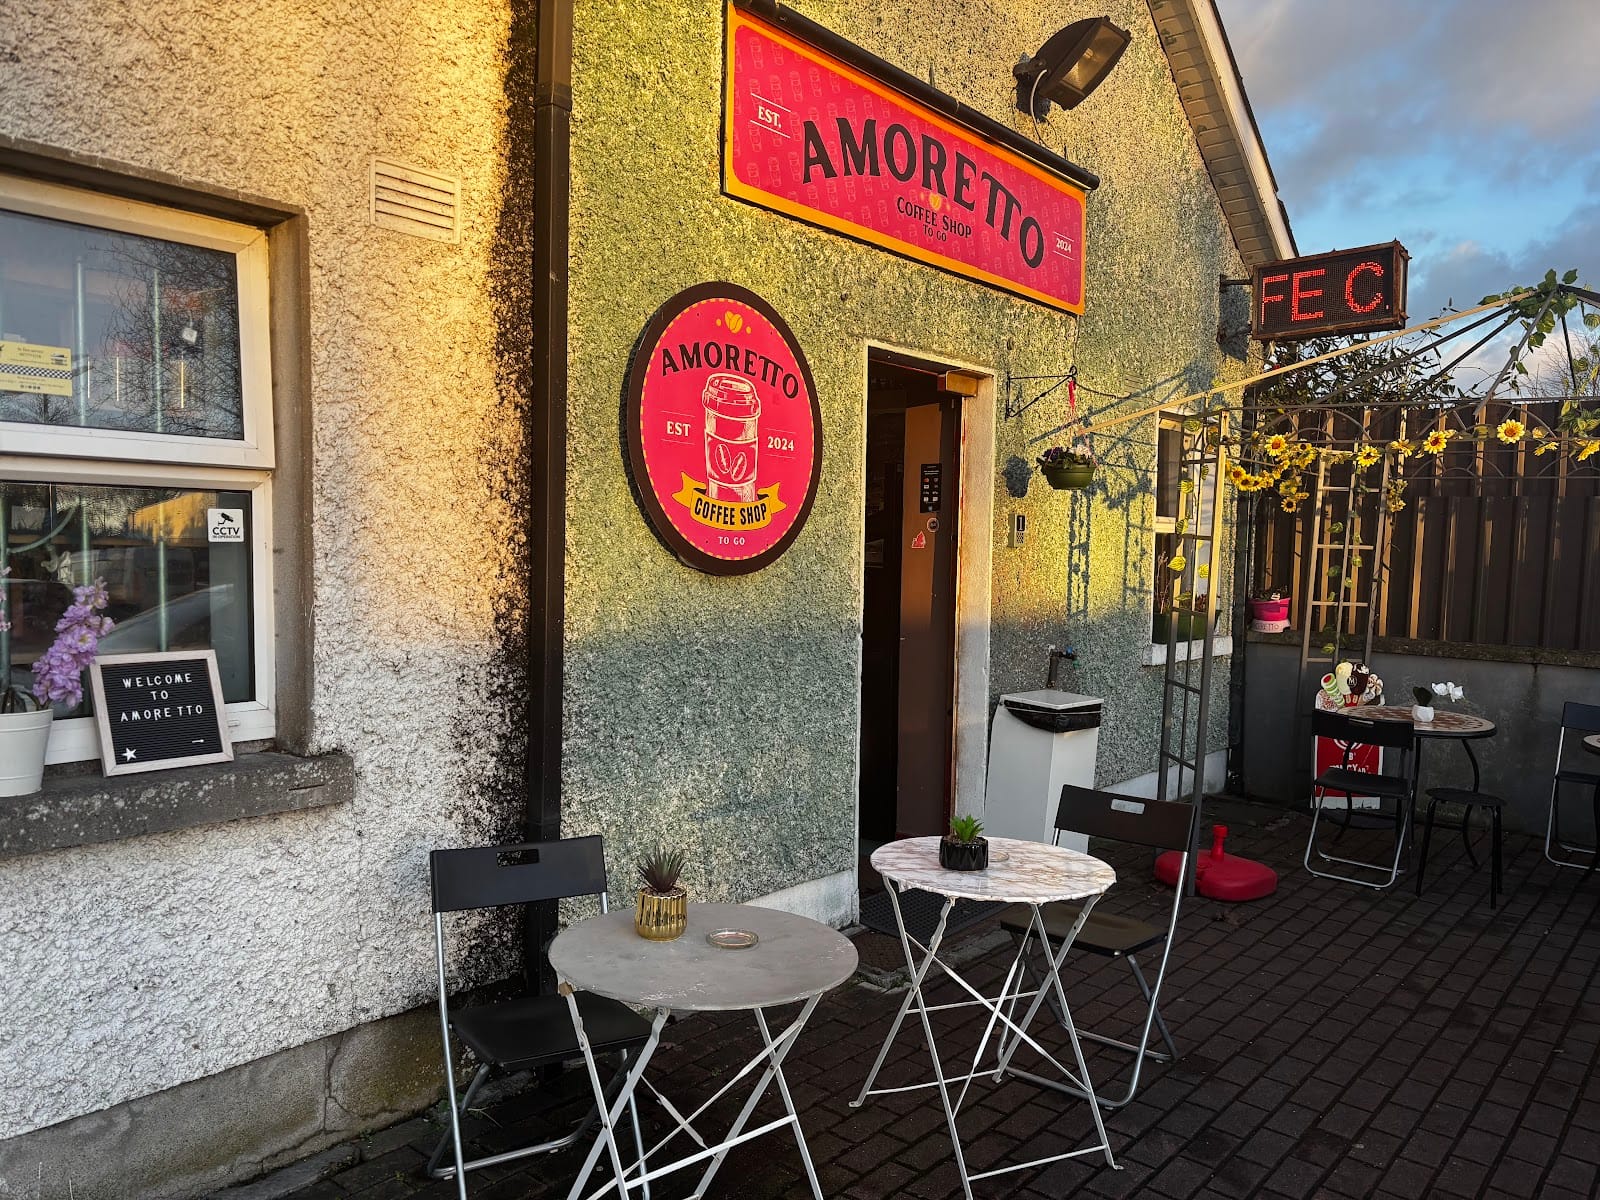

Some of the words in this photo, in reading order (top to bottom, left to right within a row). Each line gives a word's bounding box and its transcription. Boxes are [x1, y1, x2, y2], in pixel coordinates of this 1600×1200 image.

[757, 105, 782, 129] EST.
[802, 117, 1045, 269] AMORETTO
[897, 196, 938, 227] COFFEE
[942, 214, 972, 239] SHOP
[923, 222, 934, 236] TO
[936, 228, 947, 242] GO
[1055, 237, 1072, 253] 2024
[661, 341, 799, 400] AMORETTO
[666, 420, 692, 437] EST
[767, 436, 795, 452] 2024
[694, 497, 735, 526] COFFEE
[740, 502, 767, 525] SHOP
[212, 526, 240, 535] CCTV
[718, 536, 730, 545] TO
[733, 537, 745, 546] GO
[122, 673, 193, 688] WELCOME
[150, 690, 169, 701] TO
